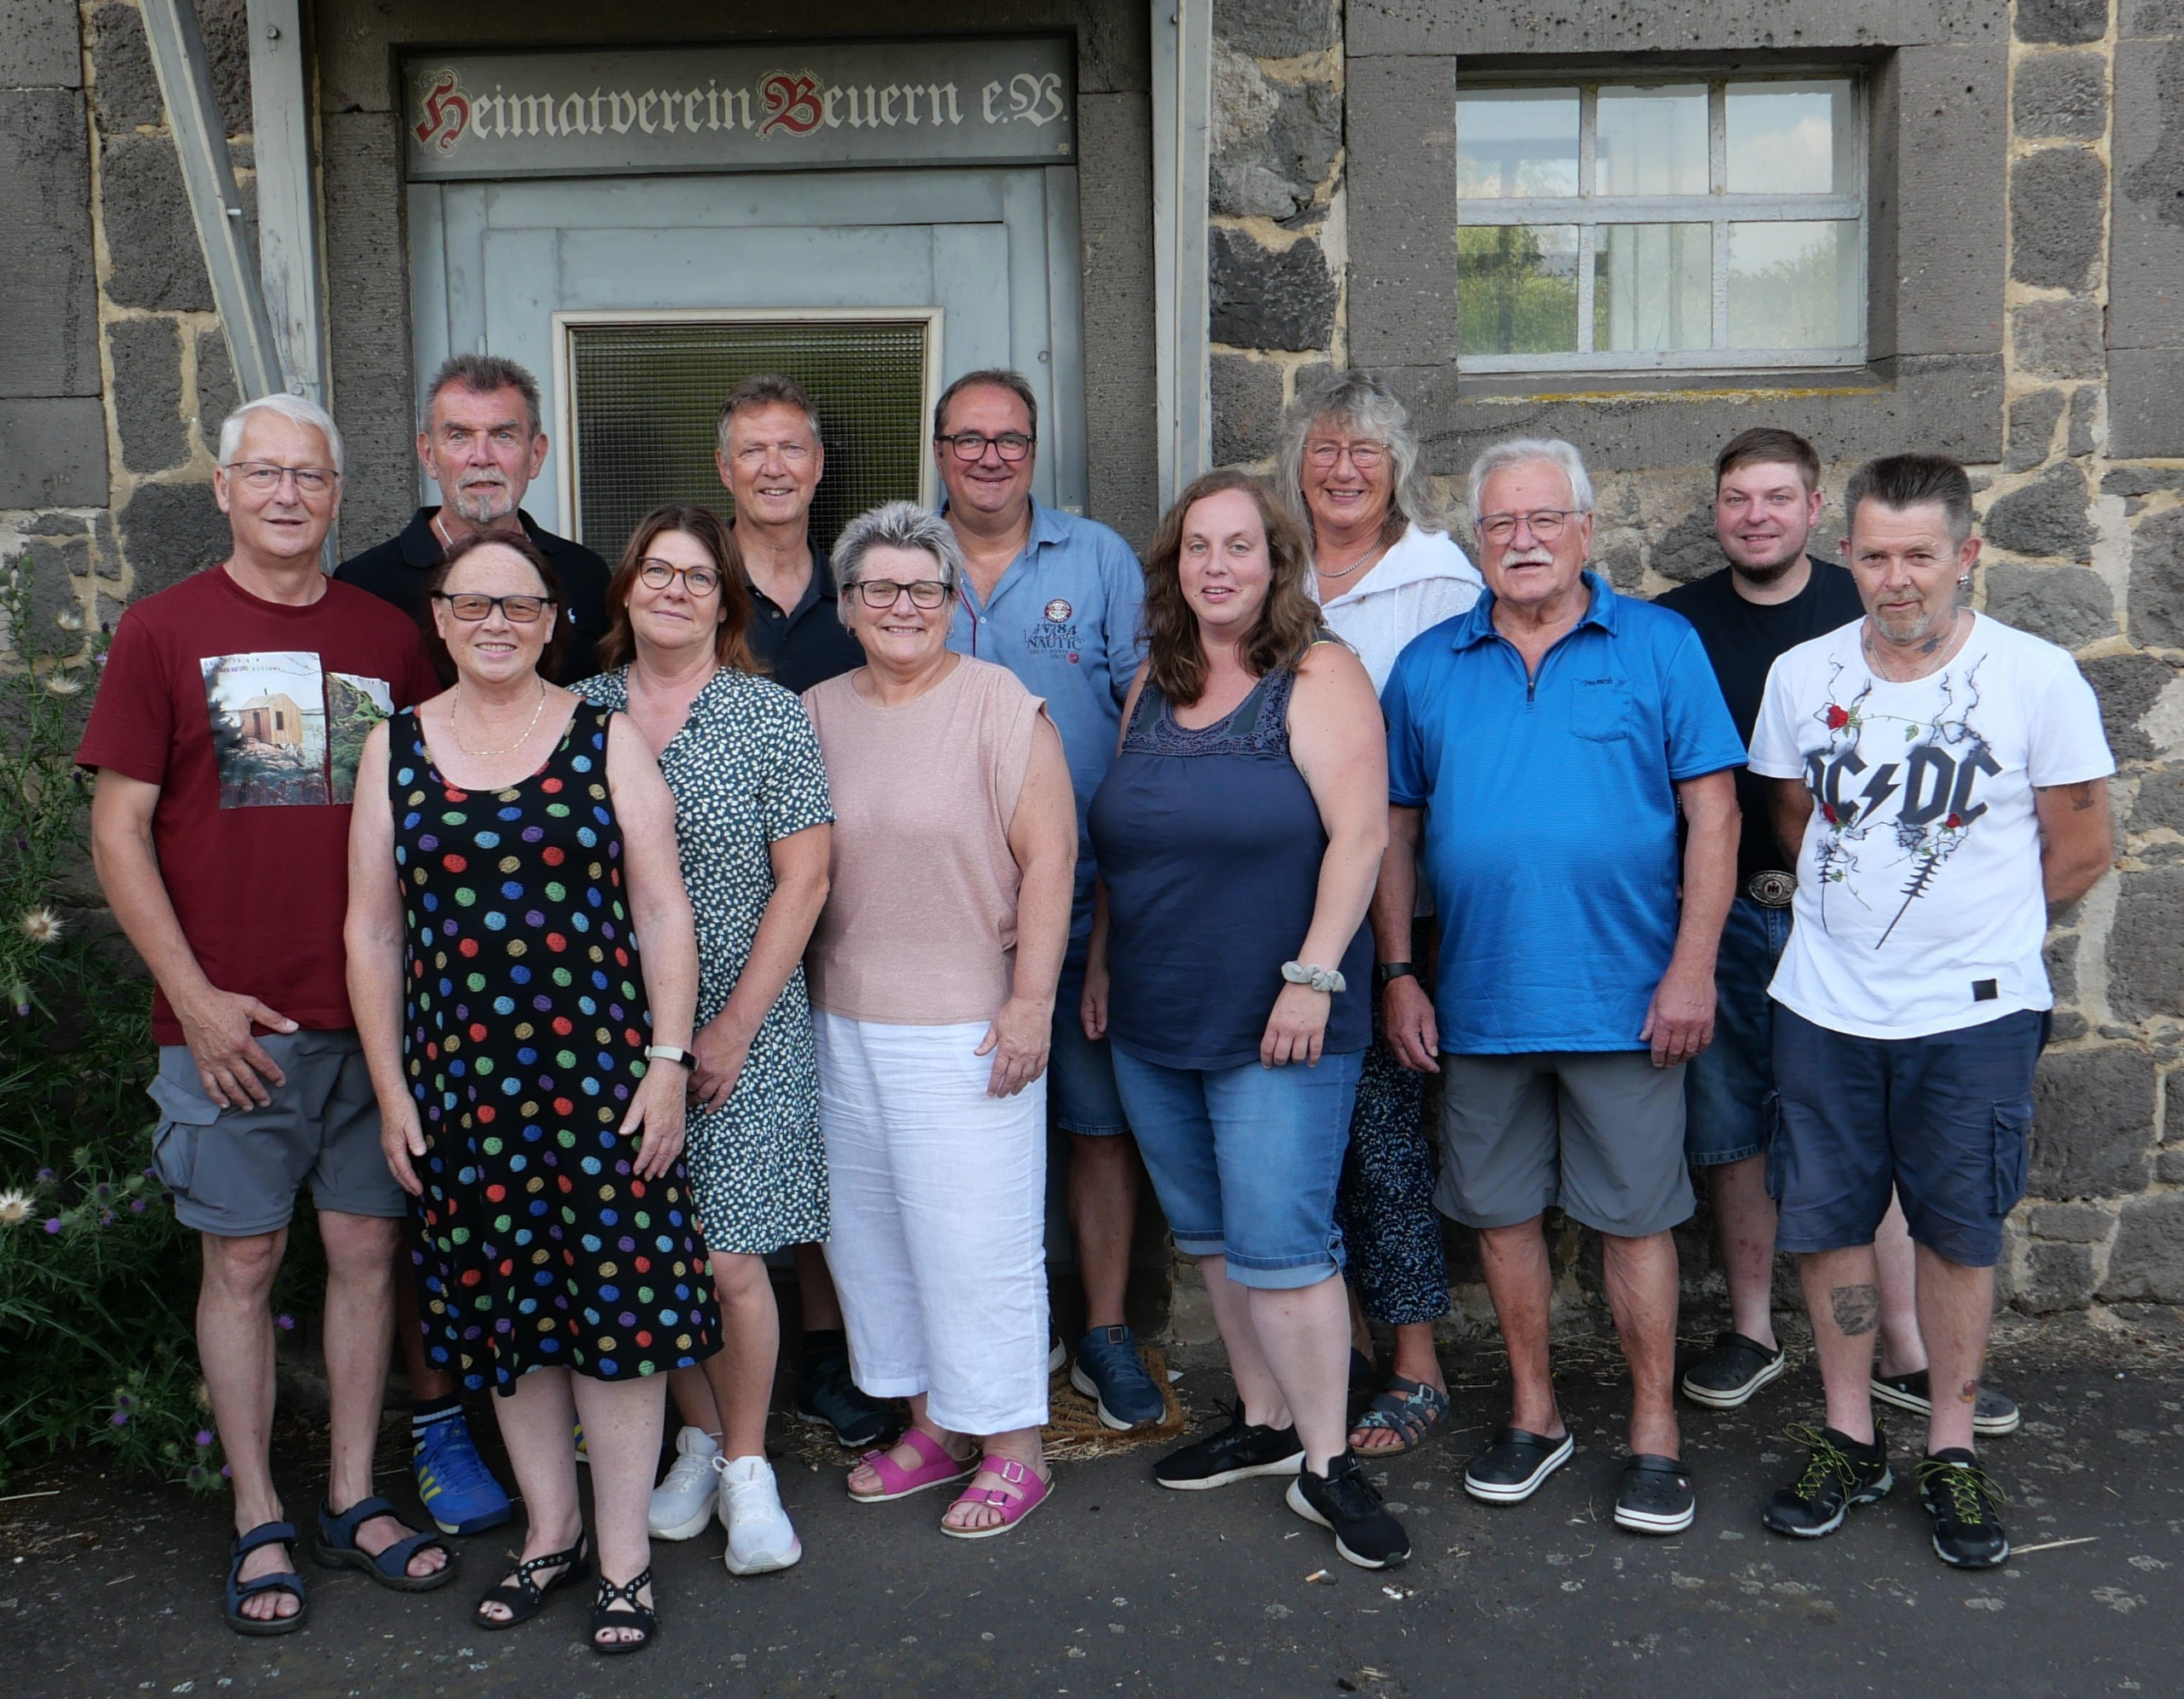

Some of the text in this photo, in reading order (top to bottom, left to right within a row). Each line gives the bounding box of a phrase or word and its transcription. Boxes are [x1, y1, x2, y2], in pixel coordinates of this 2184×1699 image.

[413, 68, 756, 155] Heimatverein
[758, 71, 964, 139] Beuern
[1027, 637, 1083, 651] NAUTIC
